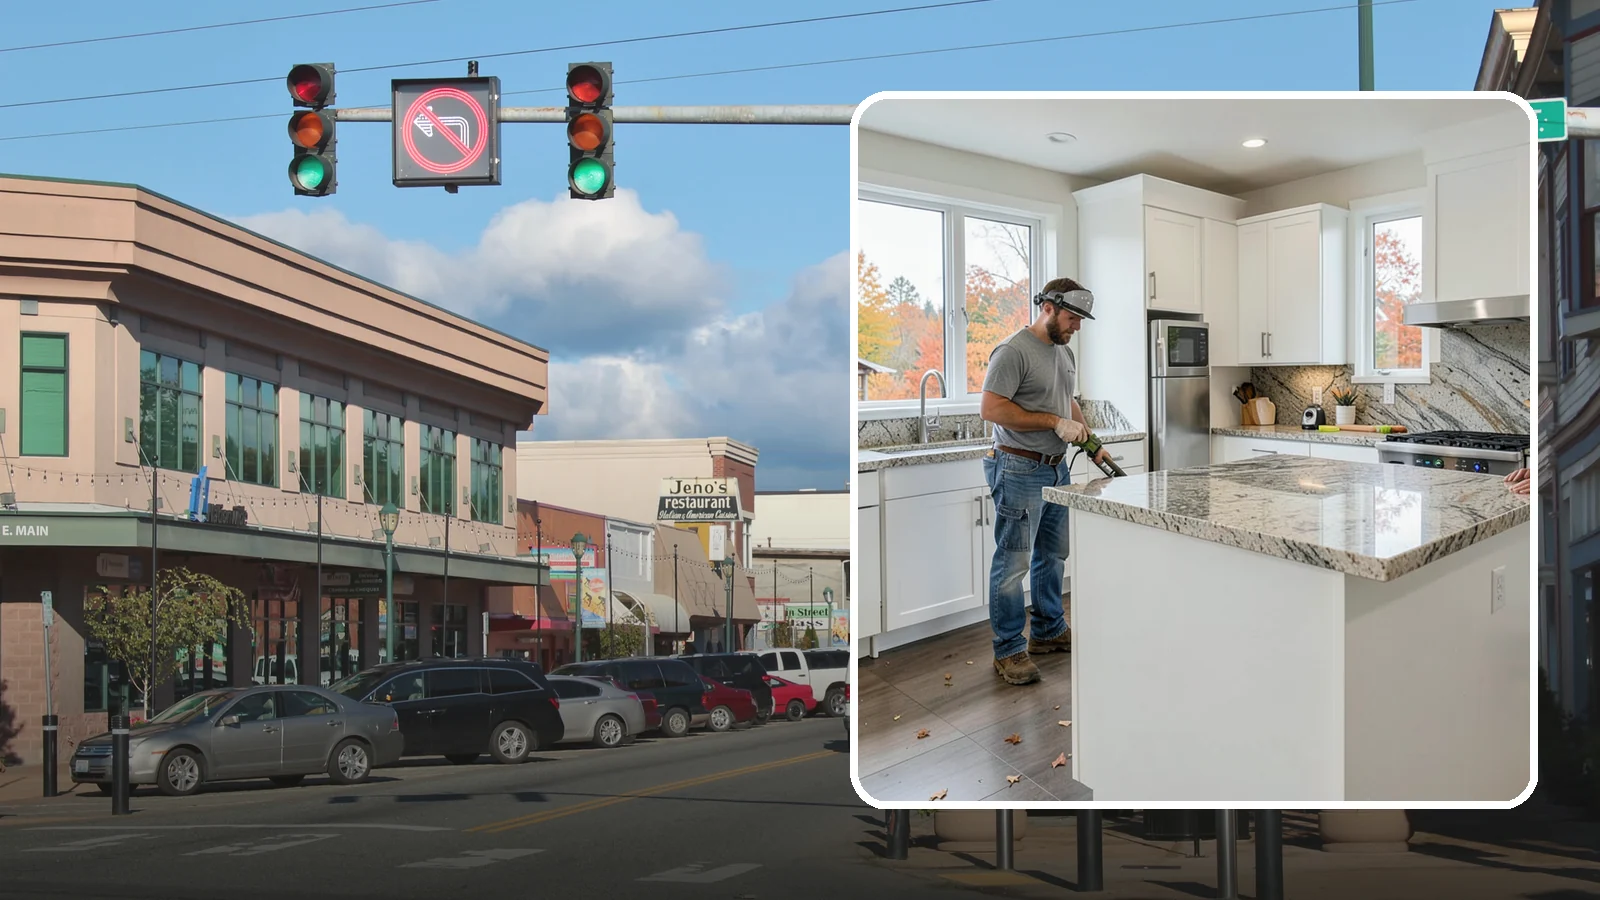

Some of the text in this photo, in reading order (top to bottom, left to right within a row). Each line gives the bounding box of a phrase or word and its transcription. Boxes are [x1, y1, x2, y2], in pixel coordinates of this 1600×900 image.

[669, 480, 728, 495] Jeno's
[665, 496, 731, 509] restaurant
[658, 509, 681, 519] Italian
[686, 509, 715, 519] American
[715, 509, 738, 519] Cuisine
[2, 525, 49, 537] E. MAIN
[785, 607, 795, 617] in
[797, 607, 829, 617] Street
[790, 619, 824, 627] lass
